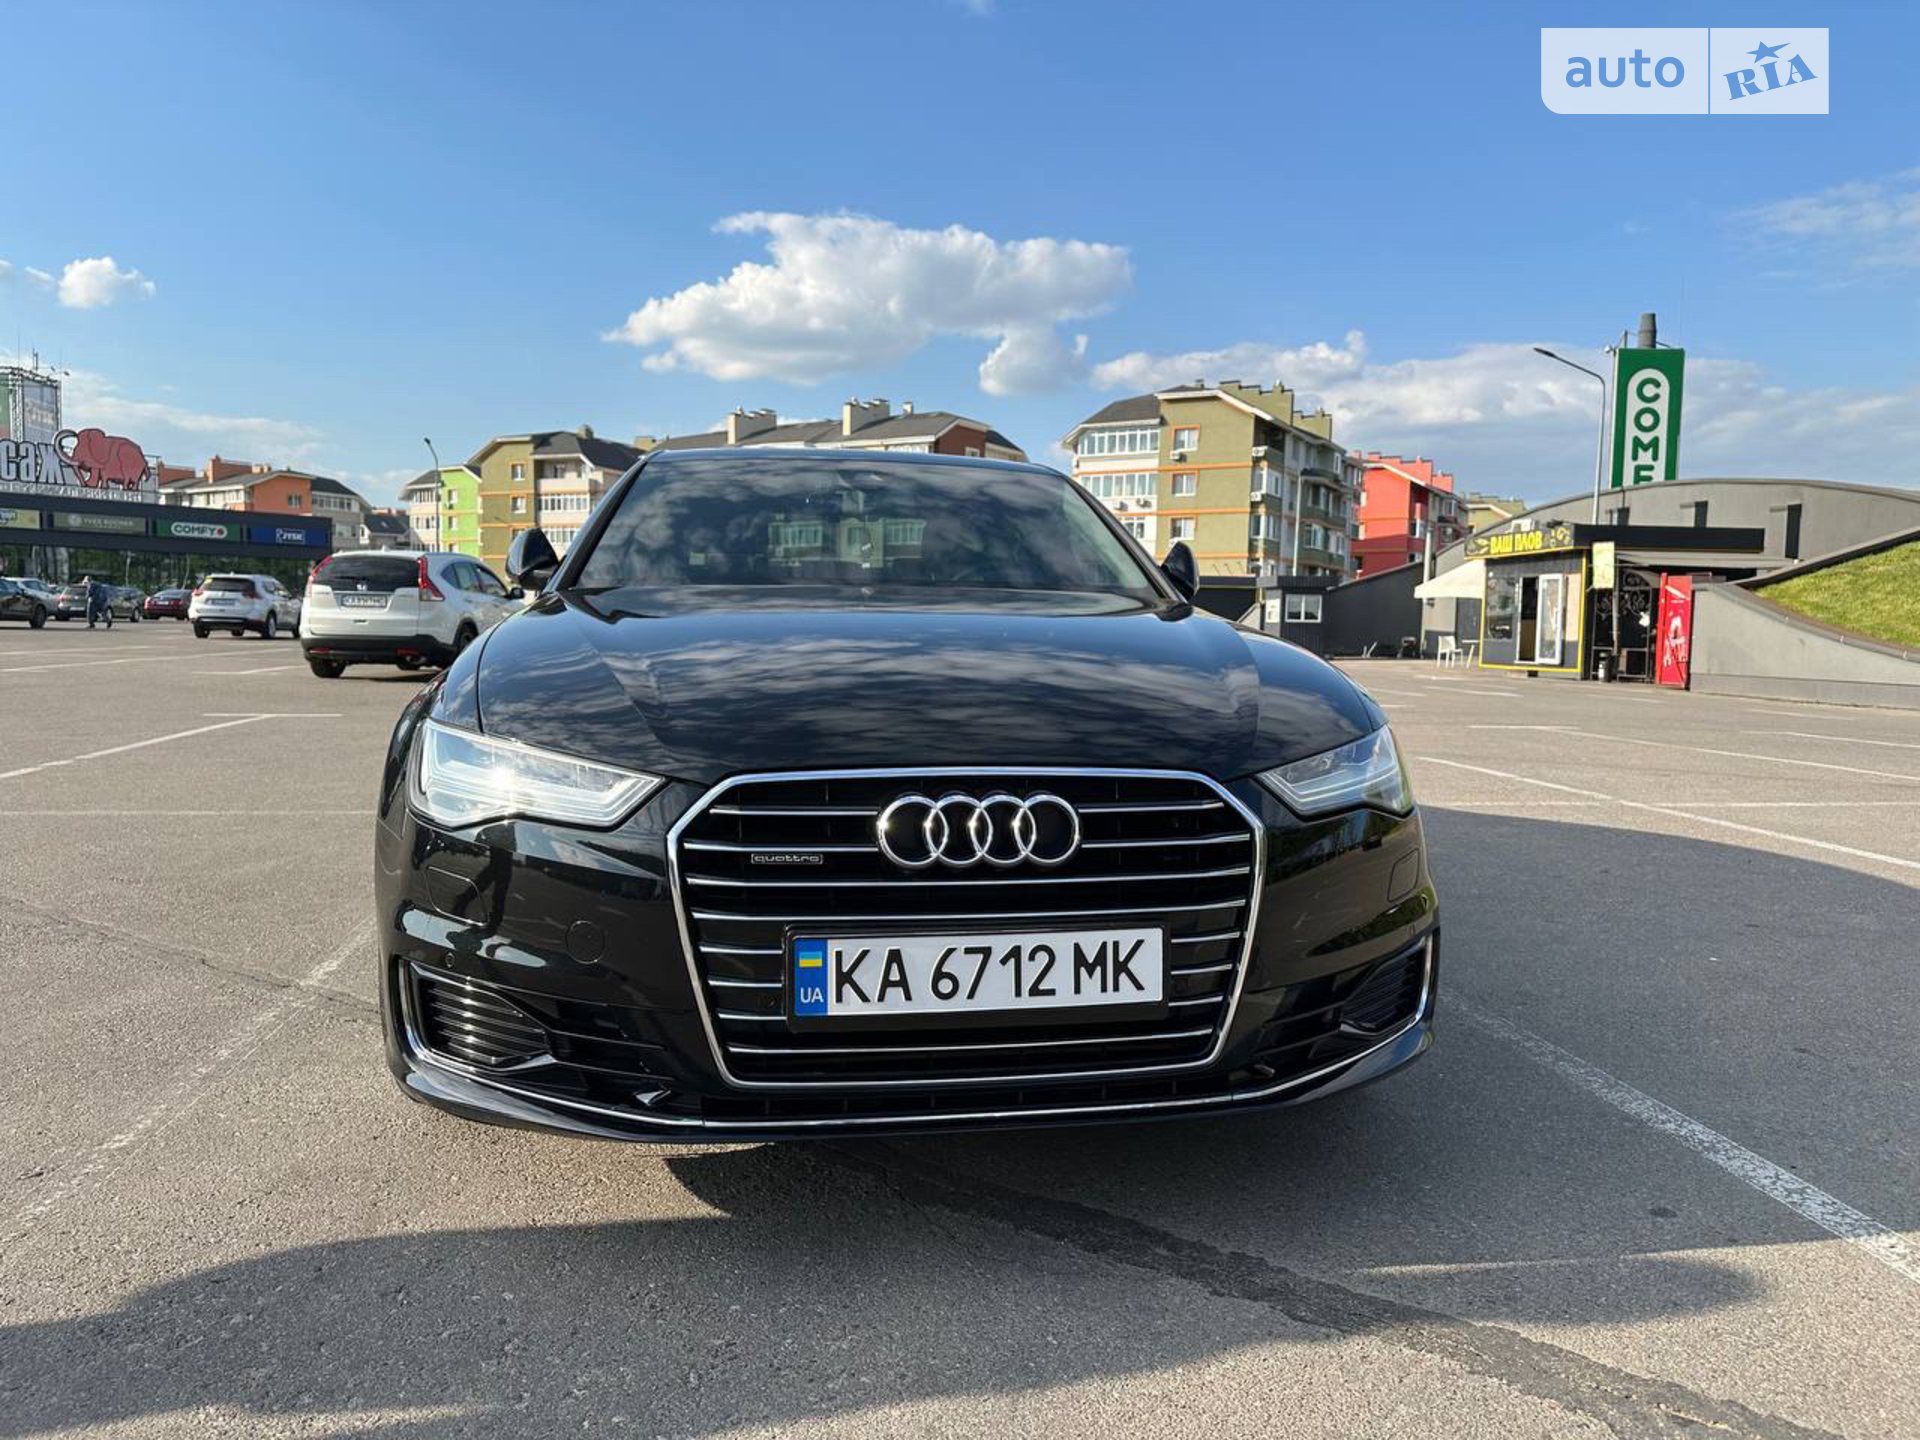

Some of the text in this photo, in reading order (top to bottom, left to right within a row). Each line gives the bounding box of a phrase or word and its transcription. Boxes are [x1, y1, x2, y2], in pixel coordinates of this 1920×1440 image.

[174, 524, 216, 535] COMFY
[754, 855, 819, 863] quattro
[834, 939, 1145, 1004] KA 6712 MK
[800, 987, 824, 1004] UA
